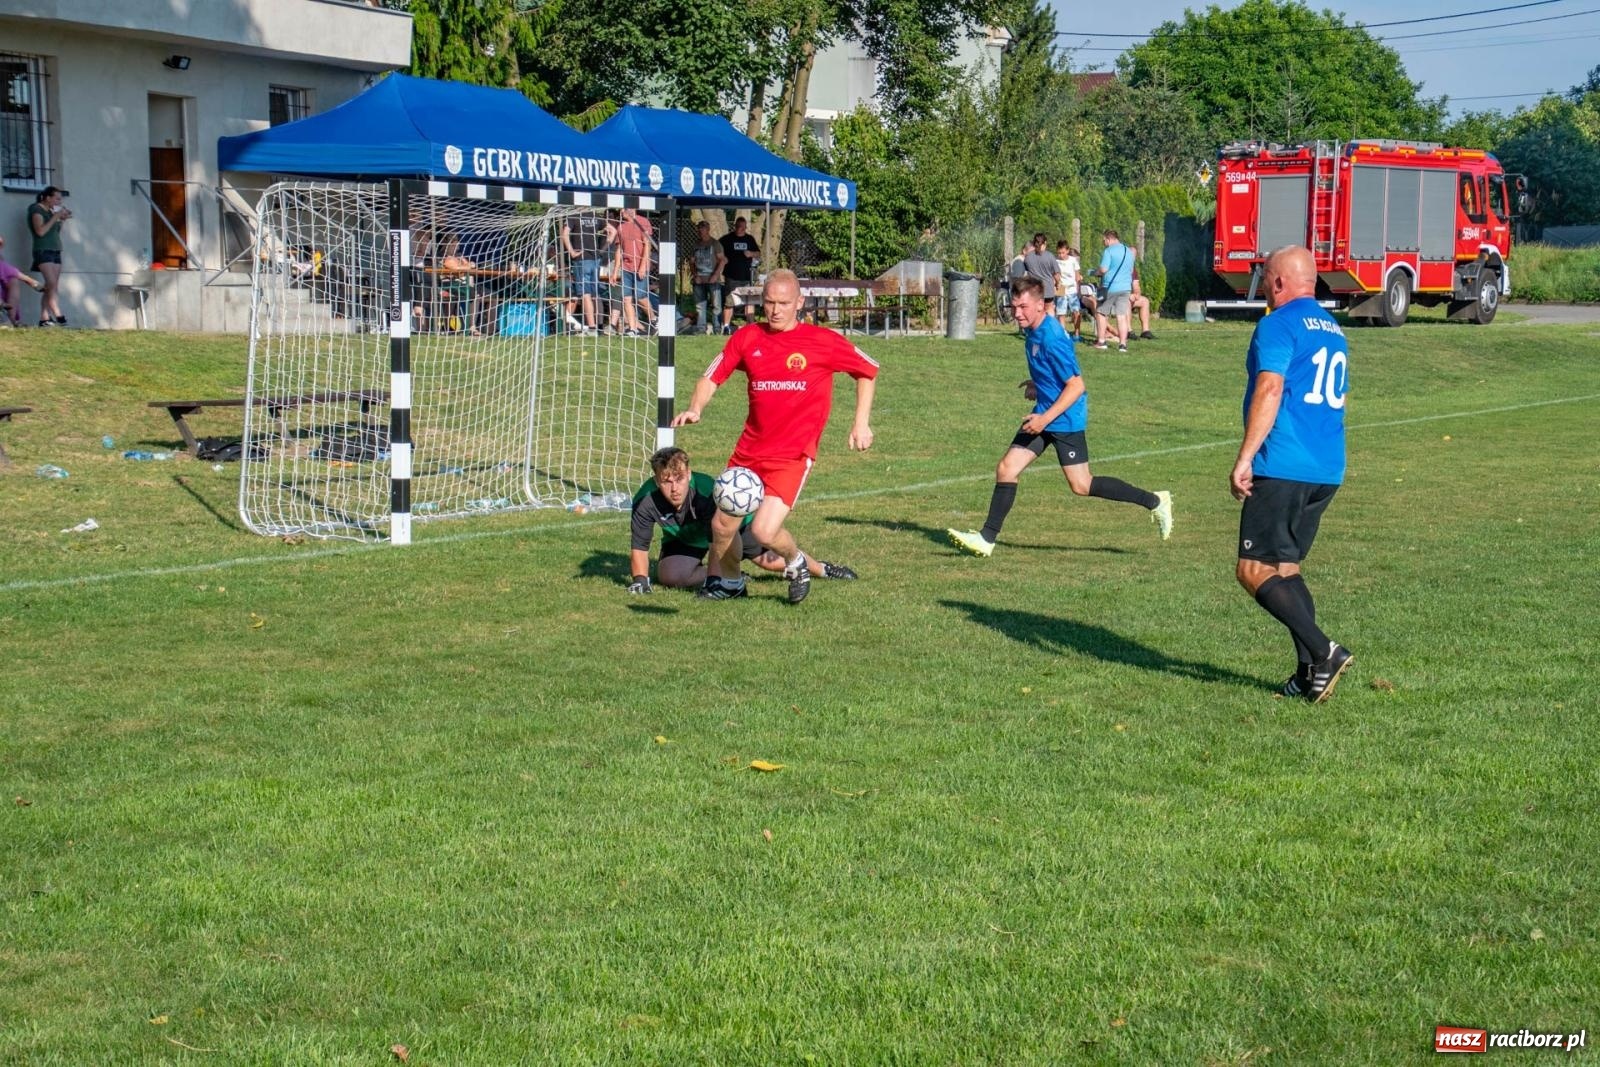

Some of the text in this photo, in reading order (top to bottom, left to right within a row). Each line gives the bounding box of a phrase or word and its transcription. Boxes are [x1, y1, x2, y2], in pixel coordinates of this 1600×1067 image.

[473, 147, 641, 189] GCBK KRZANOWICE
[702, 168, 832, 206] GCBK KRZANOWICE
[1303, 346, 1347, 410] 10
